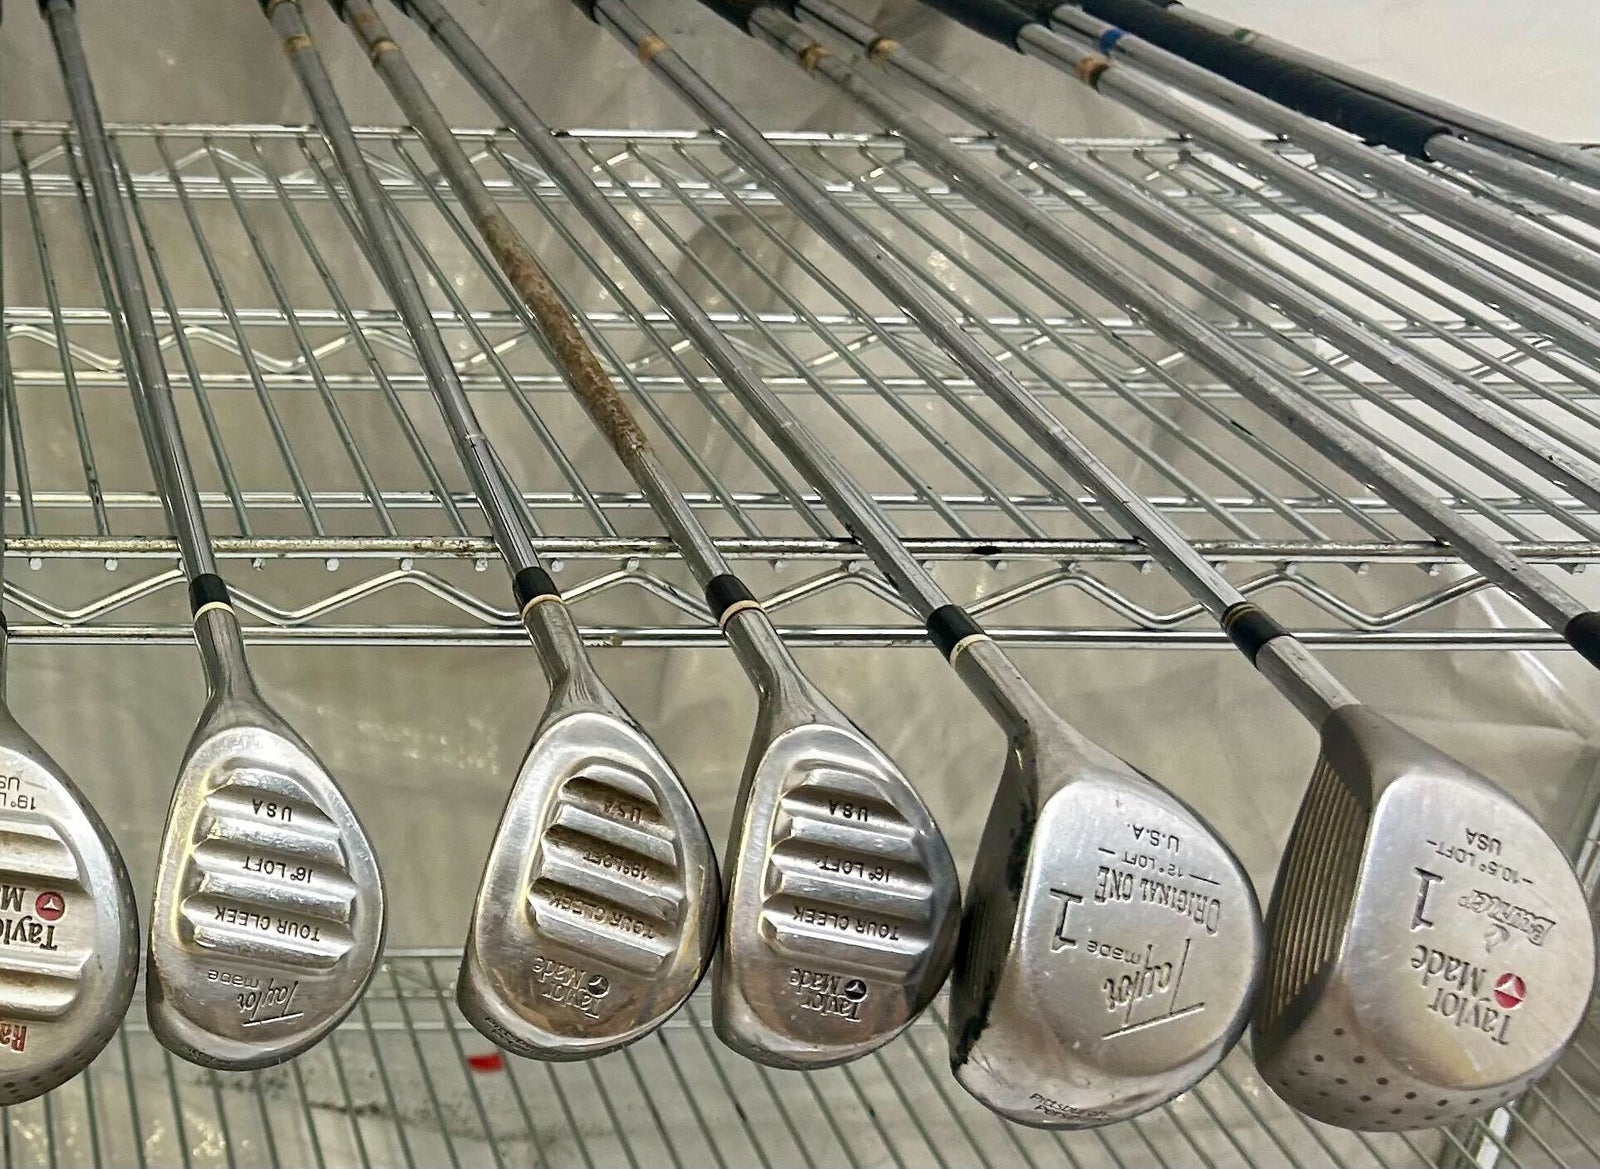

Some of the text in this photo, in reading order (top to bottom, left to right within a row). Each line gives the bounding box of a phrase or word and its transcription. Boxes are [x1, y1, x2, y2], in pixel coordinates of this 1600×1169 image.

[251, 799, 292, 822] USA
[828, 801, 869, 822] USA
[1464, 827, 1502, 855] USA
[242, 855, 285, 877] LOFT
[818, 856, 865, 878] LOFT
[1121, 849, 1156, 870] LOFT
[1436, 843, 1476, 868] LOFT
[1094, 866, 1221, 936] ORIGINAL ONE
[214, 905, 320, 942] TOUR CLEEK
[793, 905, 900, 941] TOUR CLEEK
[1410, 943, 1488, 997] Made
[1426, 987, 1512, 1047] Taylor
